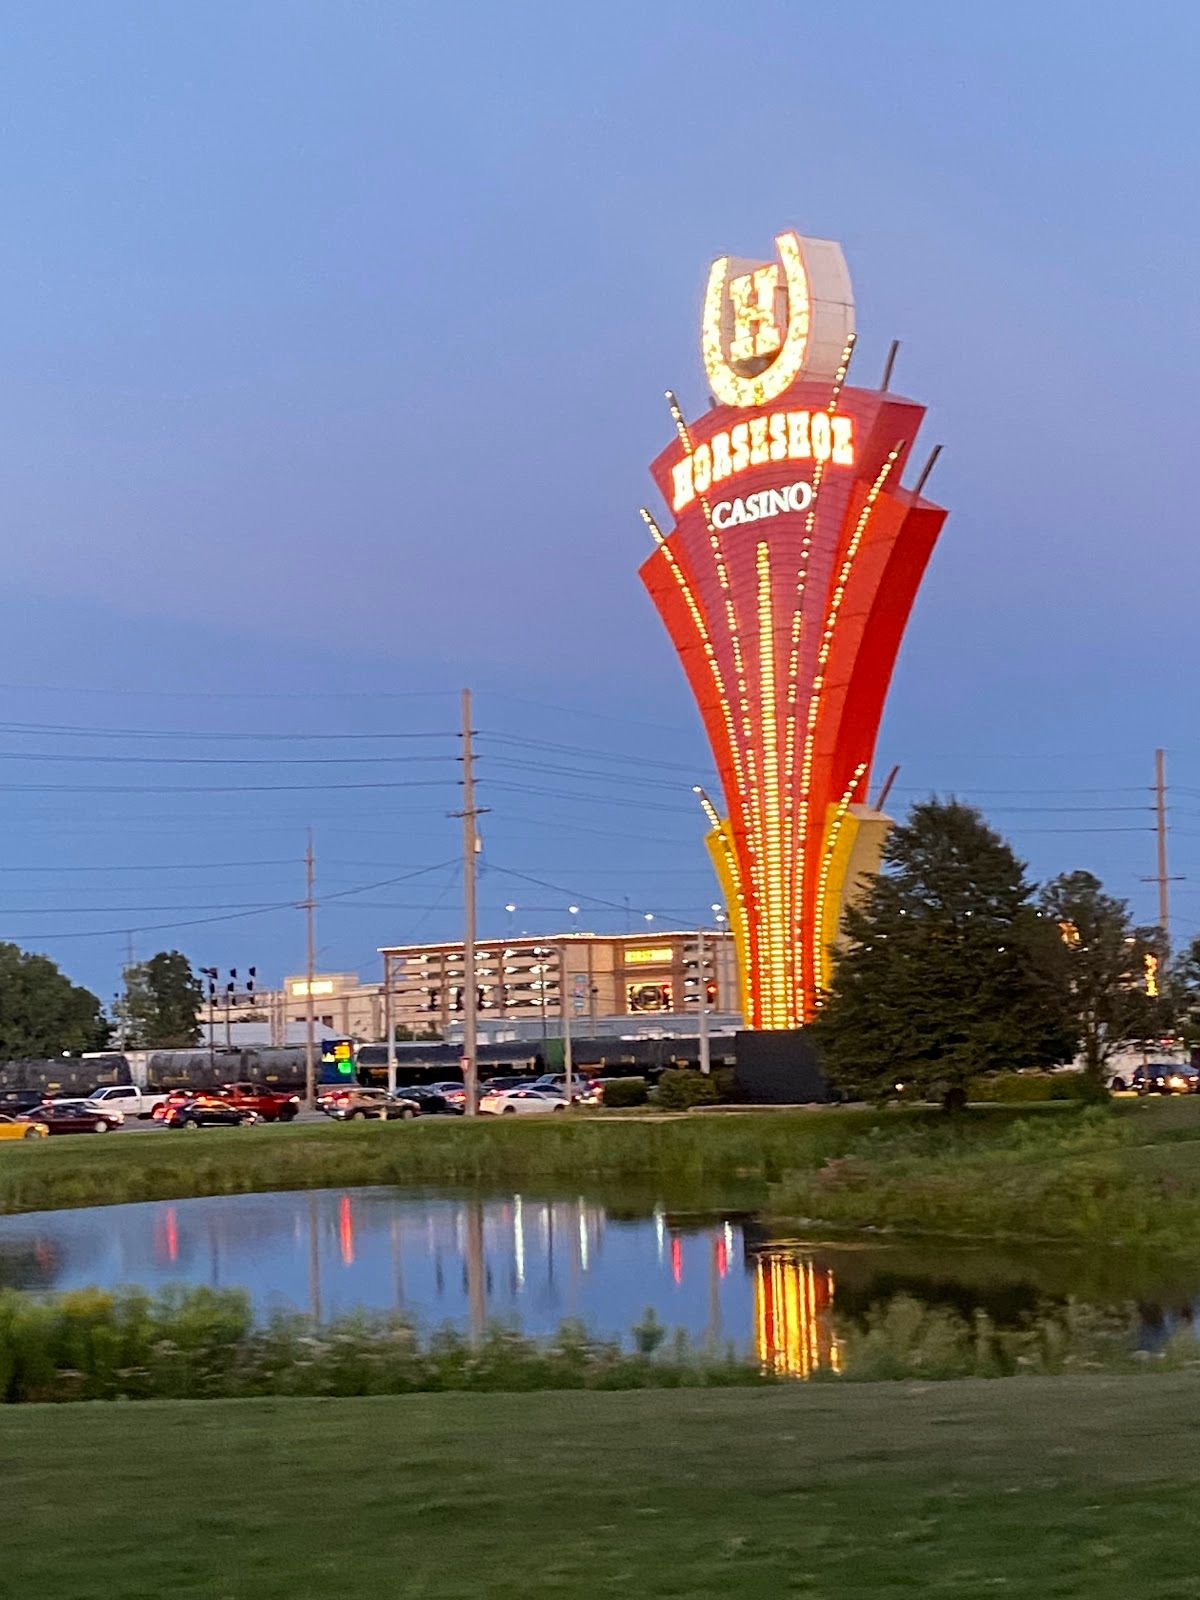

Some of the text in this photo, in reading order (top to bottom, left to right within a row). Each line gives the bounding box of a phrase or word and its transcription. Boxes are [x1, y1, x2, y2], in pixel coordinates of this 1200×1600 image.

[729, 264, 781, 362] H
[672, 411, 855, 512] HORSESHOE
[711, 481, 813, 529] CASINO
